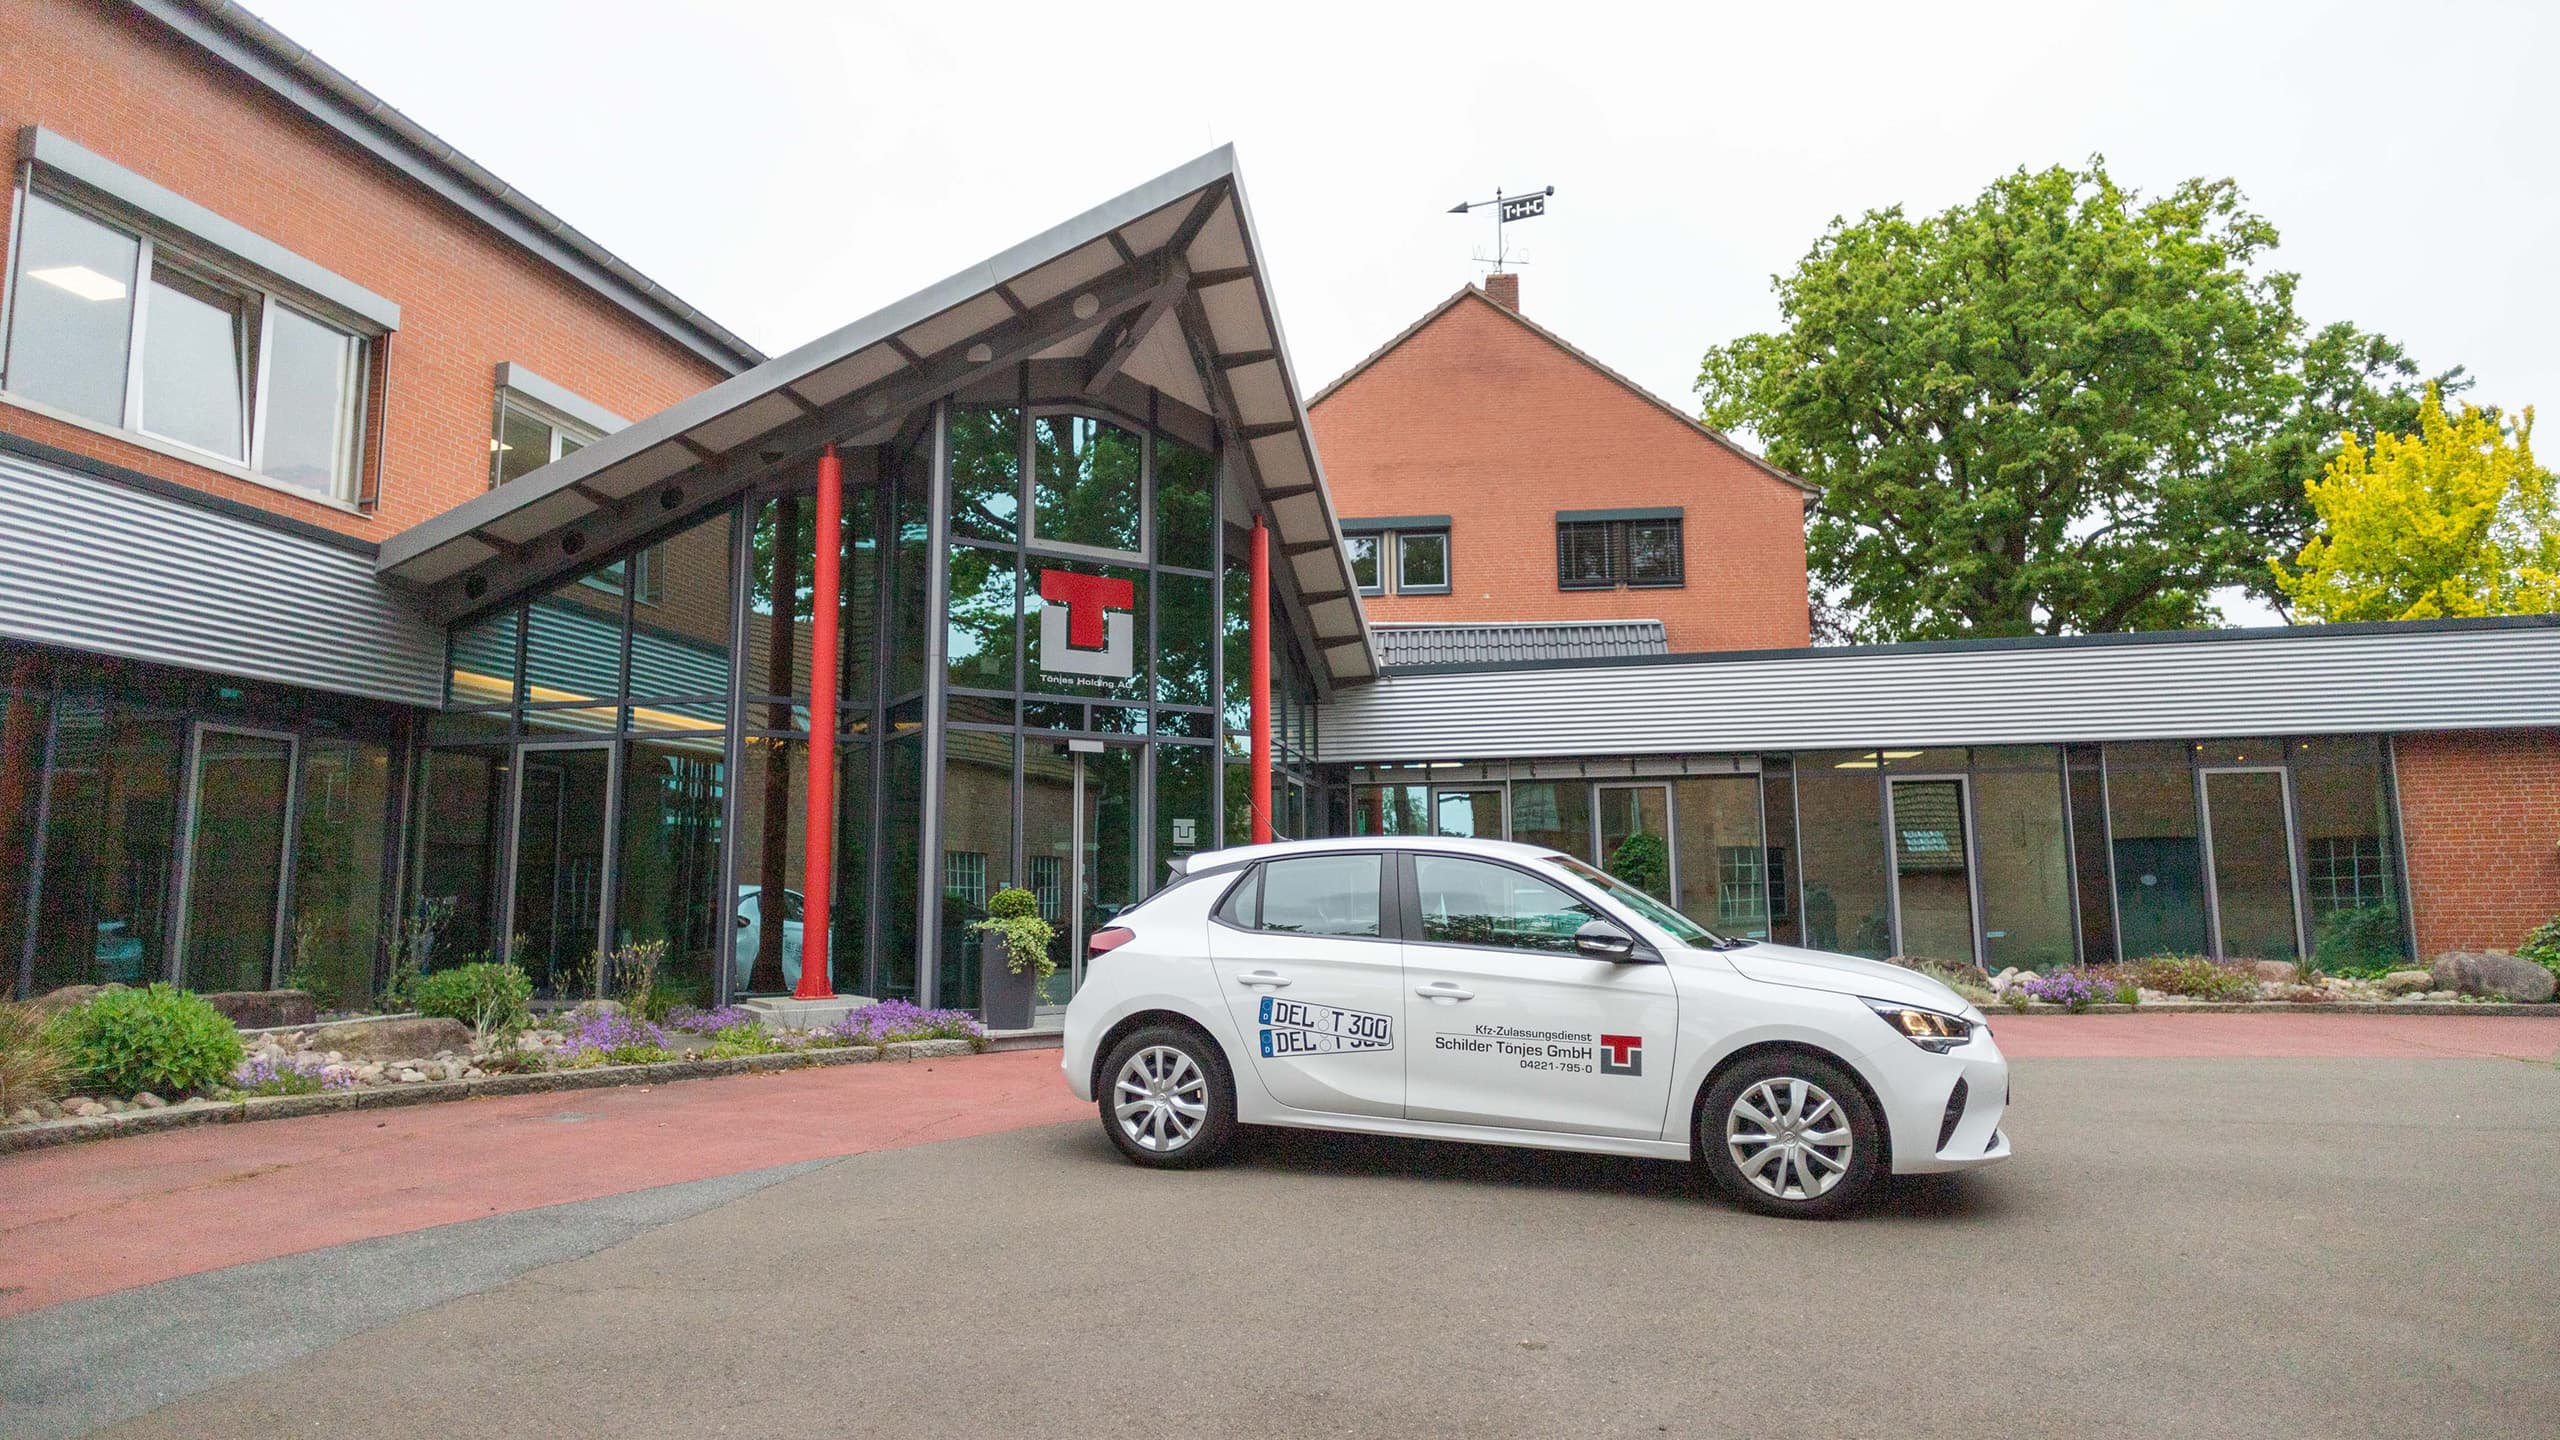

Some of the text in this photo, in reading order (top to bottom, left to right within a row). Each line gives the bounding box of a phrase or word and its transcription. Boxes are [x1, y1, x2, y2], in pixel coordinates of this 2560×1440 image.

[1040, 674, 1133, 689] Tönjes Holding AG
[1275, 1002, 1314, 1028] DEL
[1332, 1011, 1344, 1032] T
[1348, 1014, 1387, 1039] 300
[1276, 1031, 1316, 1053] DEL
[1475, 1025, 1592, 1042] Kfz-Zulassungsdienst
[1435, 1037, 1592, 1060] Schilder Tönjes GmbH
[1520, 1060, 1592, 1074] 04221-795-0
